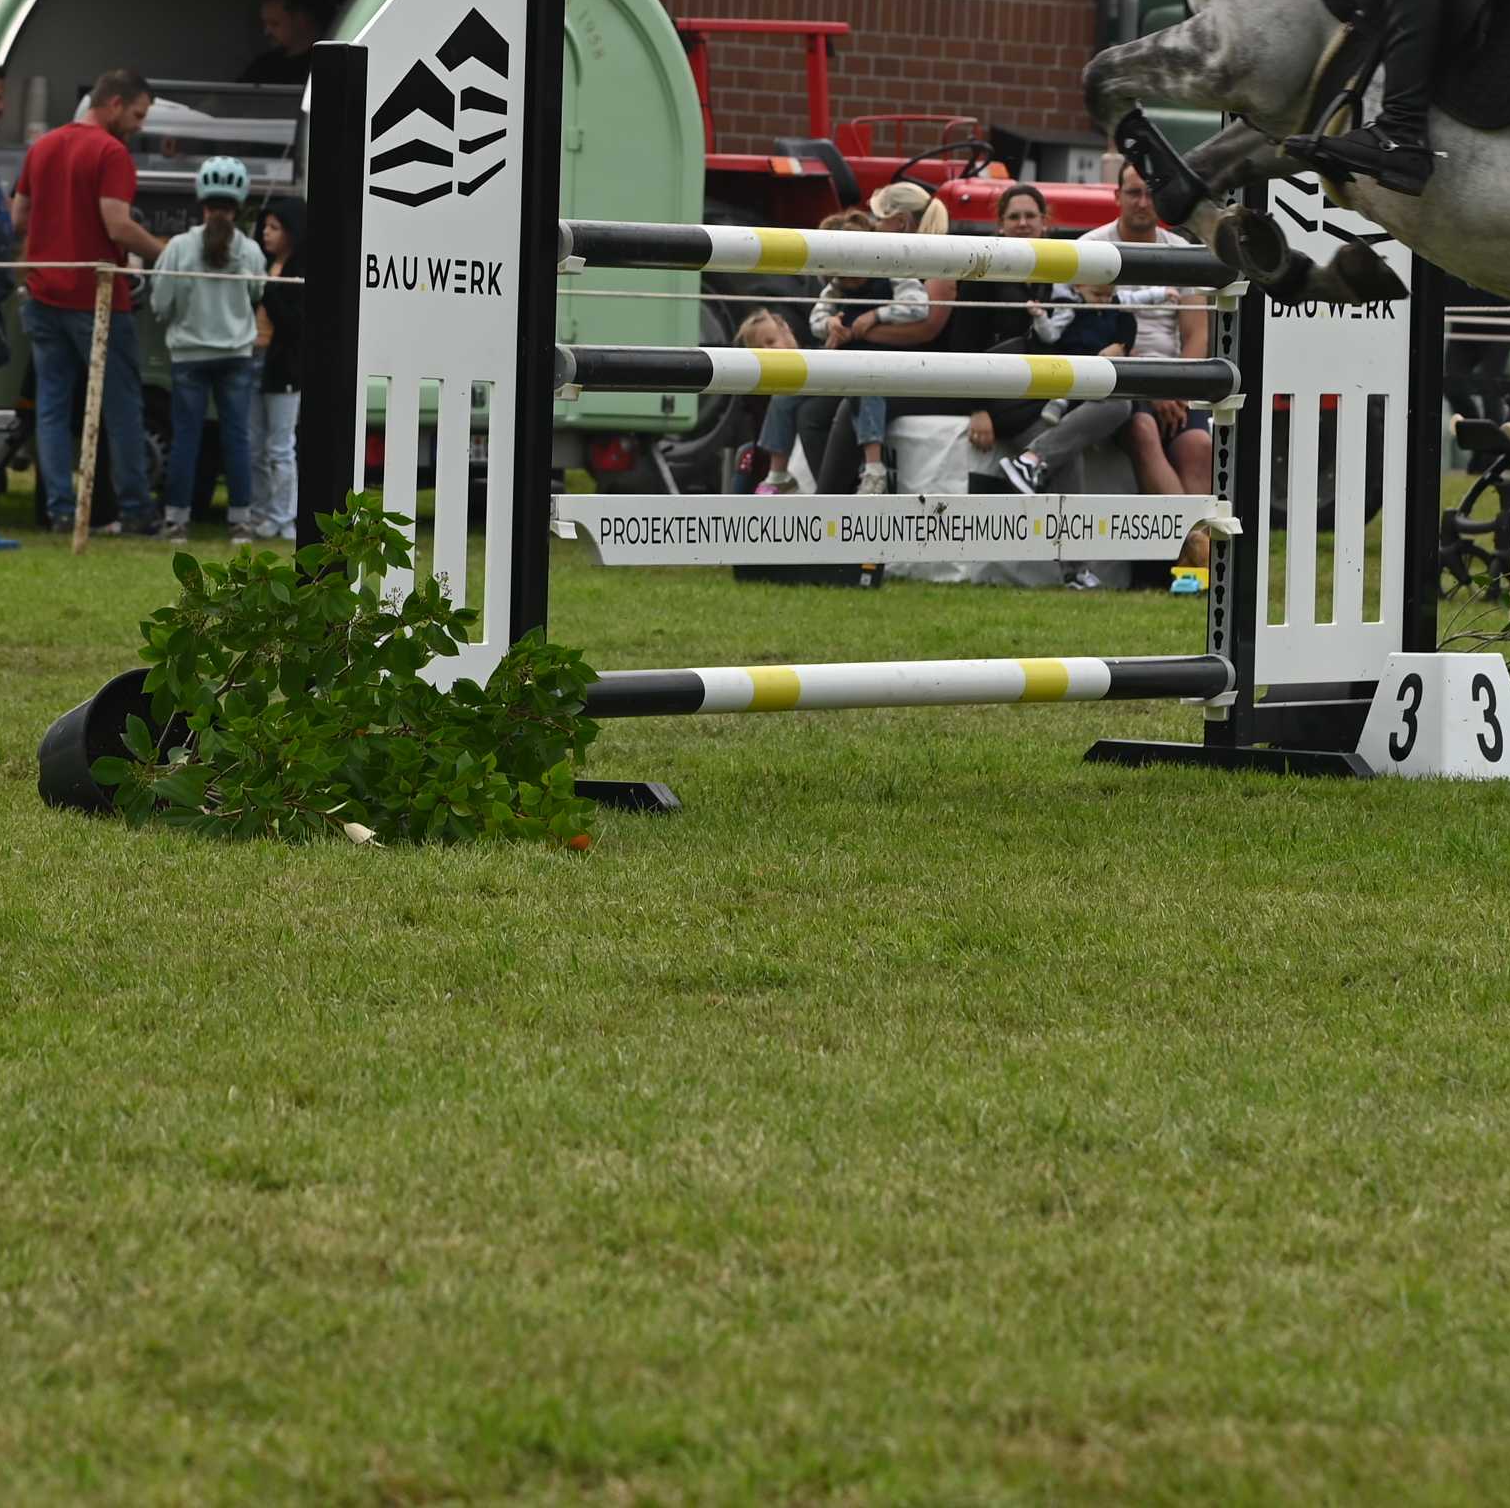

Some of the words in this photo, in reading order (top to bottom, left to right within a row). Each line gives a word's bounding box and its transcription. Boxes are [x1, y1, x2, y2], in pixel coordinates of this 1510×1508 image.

[600, 515, 823, 545] PROJEKTENTWICKLUNG
[841, 514, 1028, 543] BAUUNTERNEHMUNG
[1045, 514, 1094, 541] DACH
[1110, 514, 1184, 541] FASSADE
[1388, 672, 1424, 763] 3
[1471, 672, 1504, 764] 3
